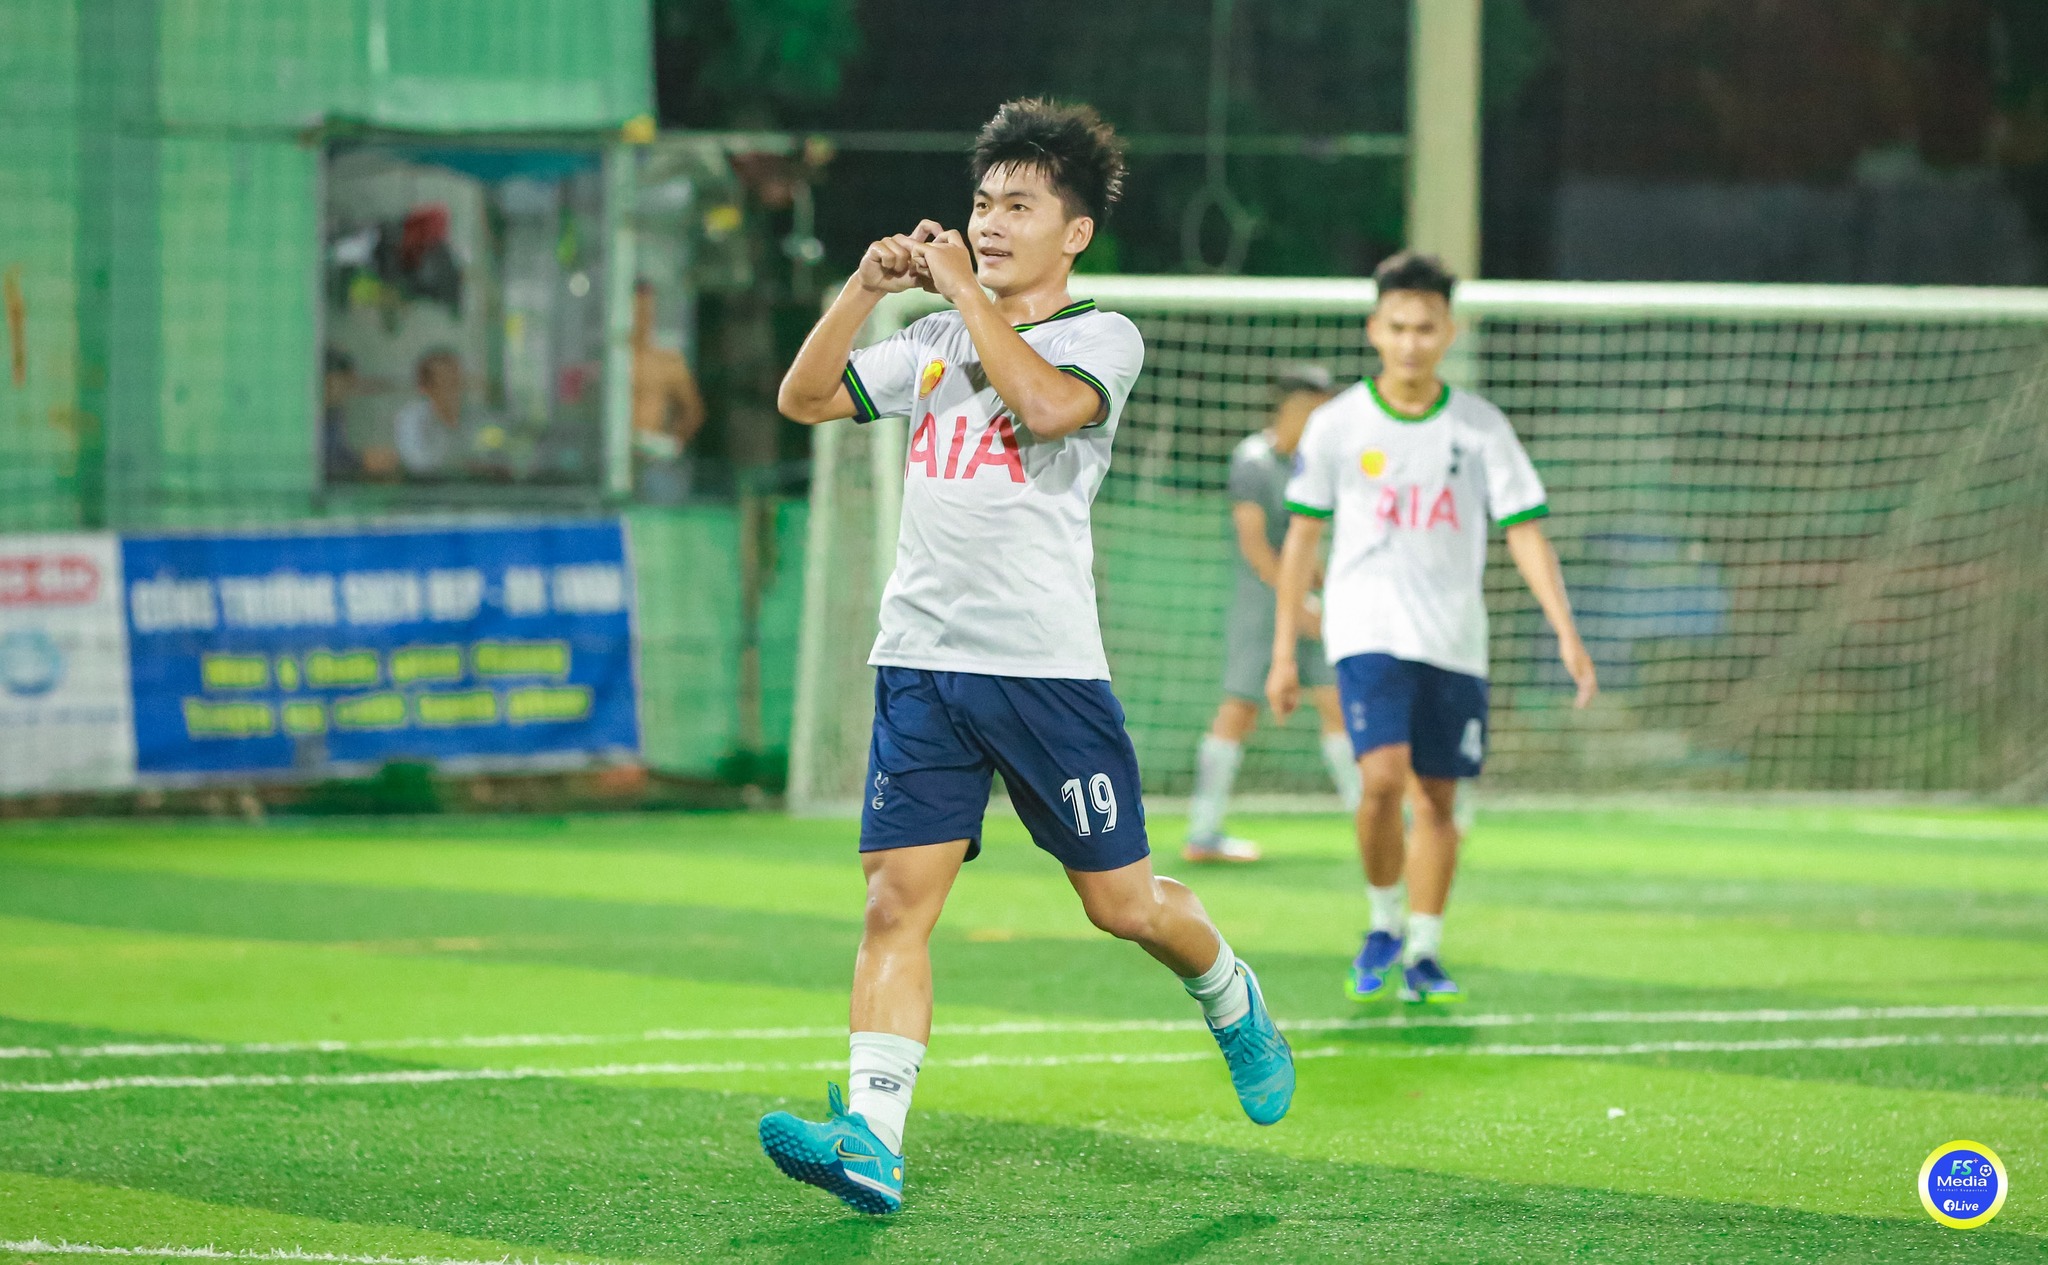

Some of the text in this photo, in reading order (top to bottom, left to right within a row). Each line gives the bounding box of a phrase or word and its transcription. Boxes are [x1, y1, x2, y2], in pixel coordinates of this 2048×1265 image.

[906, 411, 1026, 483] AIA
[1377, 484, 1460, 532] AIA
[1060, 772, 1118, 837] 19
